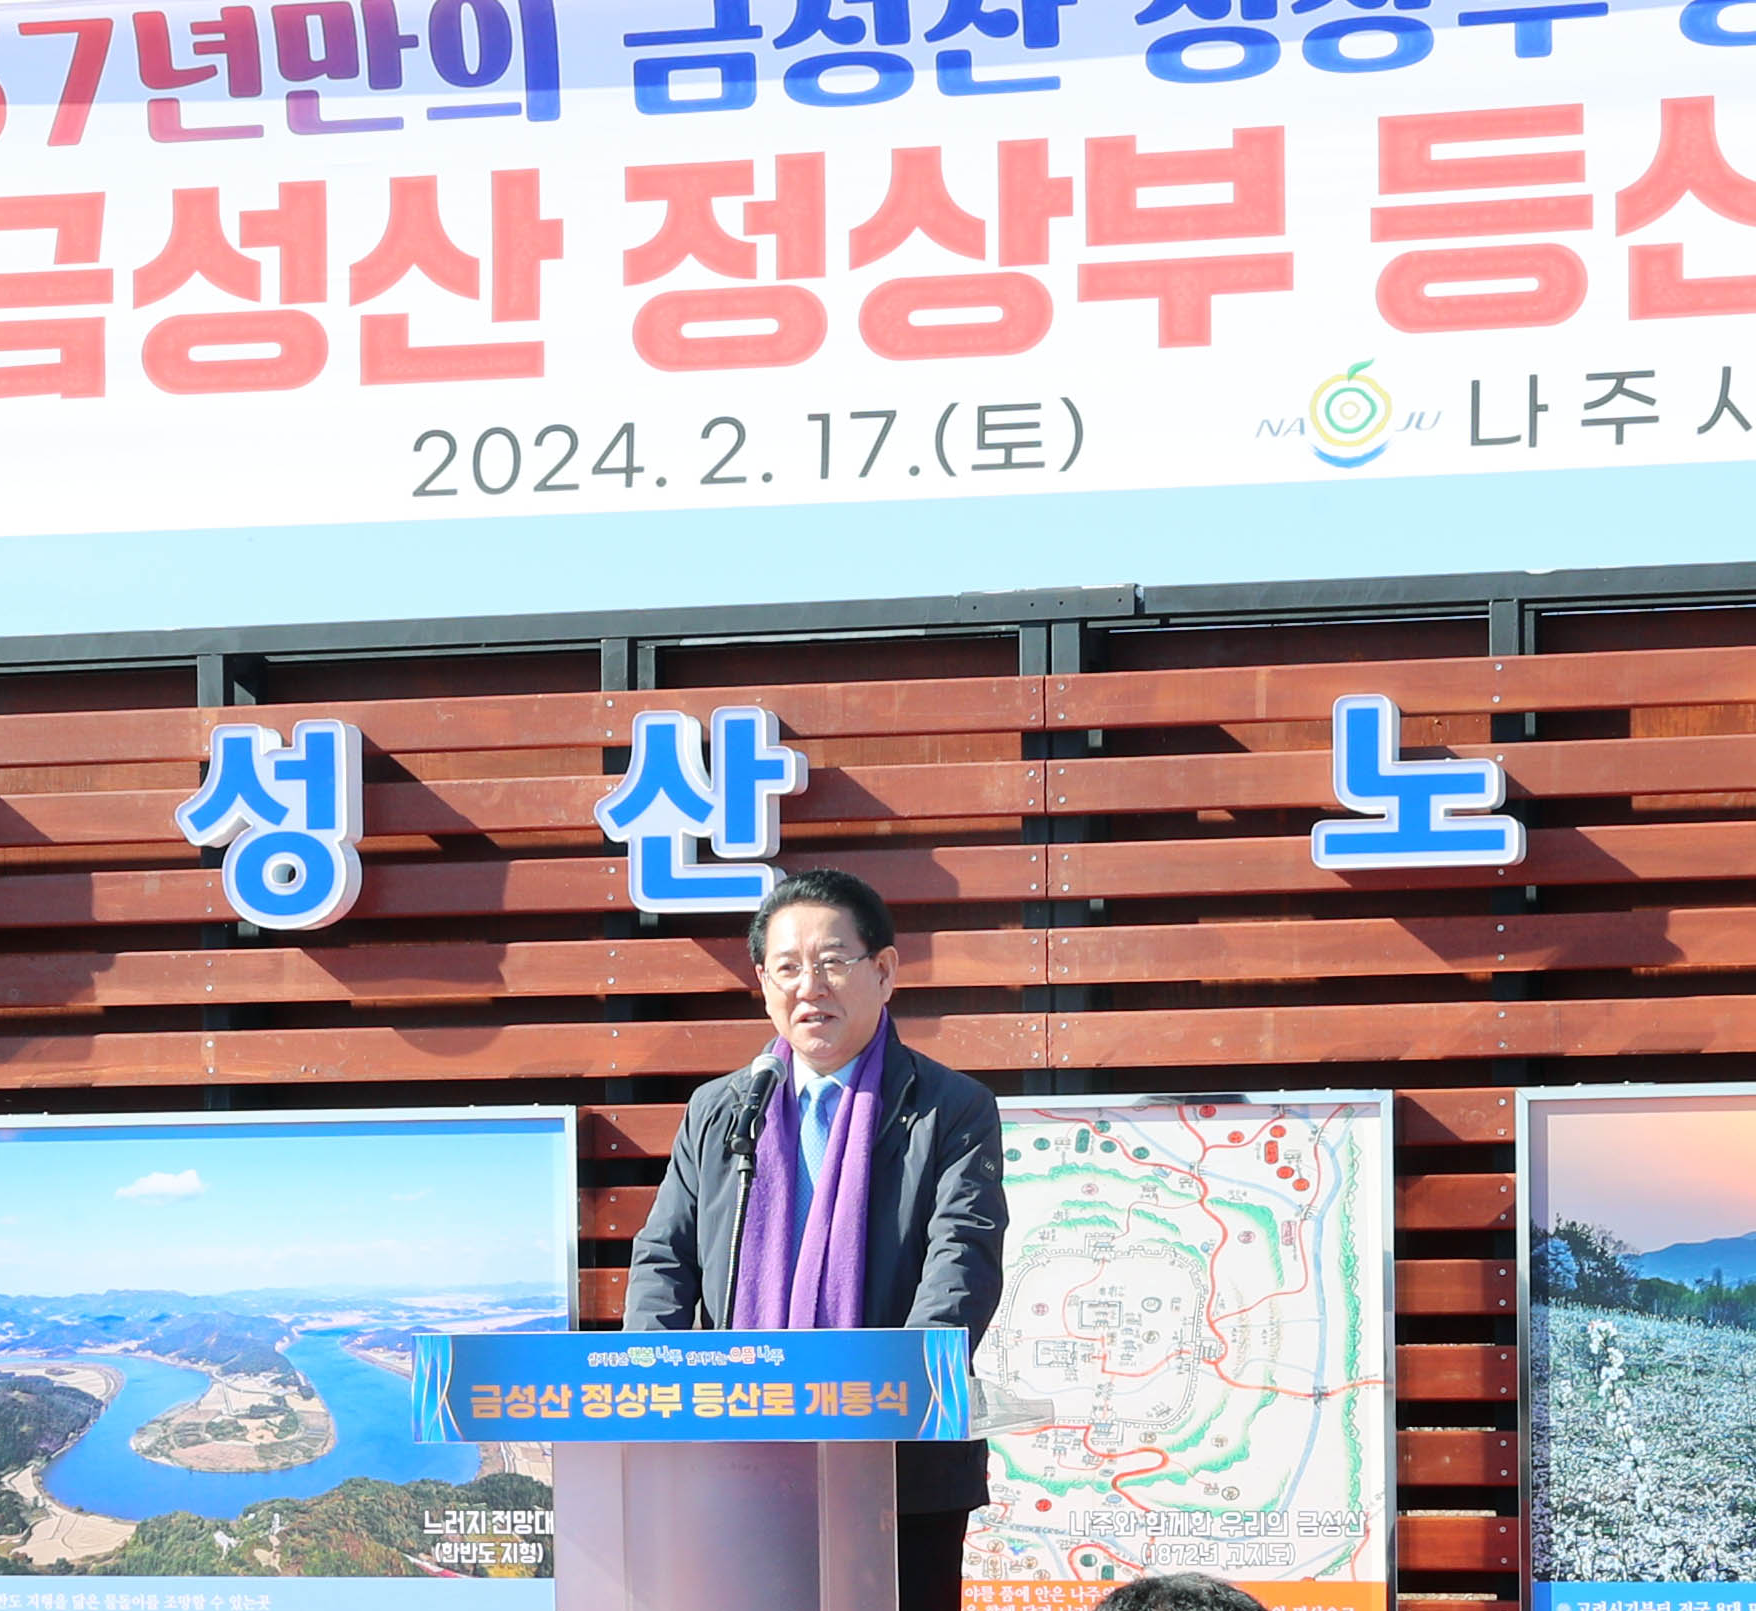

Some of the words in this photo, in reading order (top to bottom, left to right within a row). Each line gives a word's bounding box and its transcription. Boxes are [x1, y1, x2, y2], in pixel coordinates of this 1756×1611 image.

[623, 124, 1294, 374] 정상부
[410, 420, 668, 499] 2024.
[699, 415, 774, 487] 2.
[807, 396, 1086, 482] 17.(토)
[470, 1384, 572, 1420] 금성산
[581, 1383, 683, 1419] 정상부
[692, 1382, 796, 1418] 등산로
[804, 1381, 909, 1416] 개통식
[423, 1510, 486, 1535] 느러지
[493, 1510, 555, 1536] 전망대
[1068, 1510, 1137, 1537] 나주와
[1144, 1510, 1214, 1538] 함께한
[1220, 1510, 1290, 1538] 우리의
[1297, 1510, 1367, 1538] 금성산
[434, 1541, 496, 1564] (한반도
[500, 1542, 544, 1565] 지형)
[1140, 1543, 1220, 1568] (1872년
[1225, 1543, 1296, 1567] 고지도)
[999, 1586, 1030, 1603] 품에
[1035, 1586, 1066, 1603] 안은
